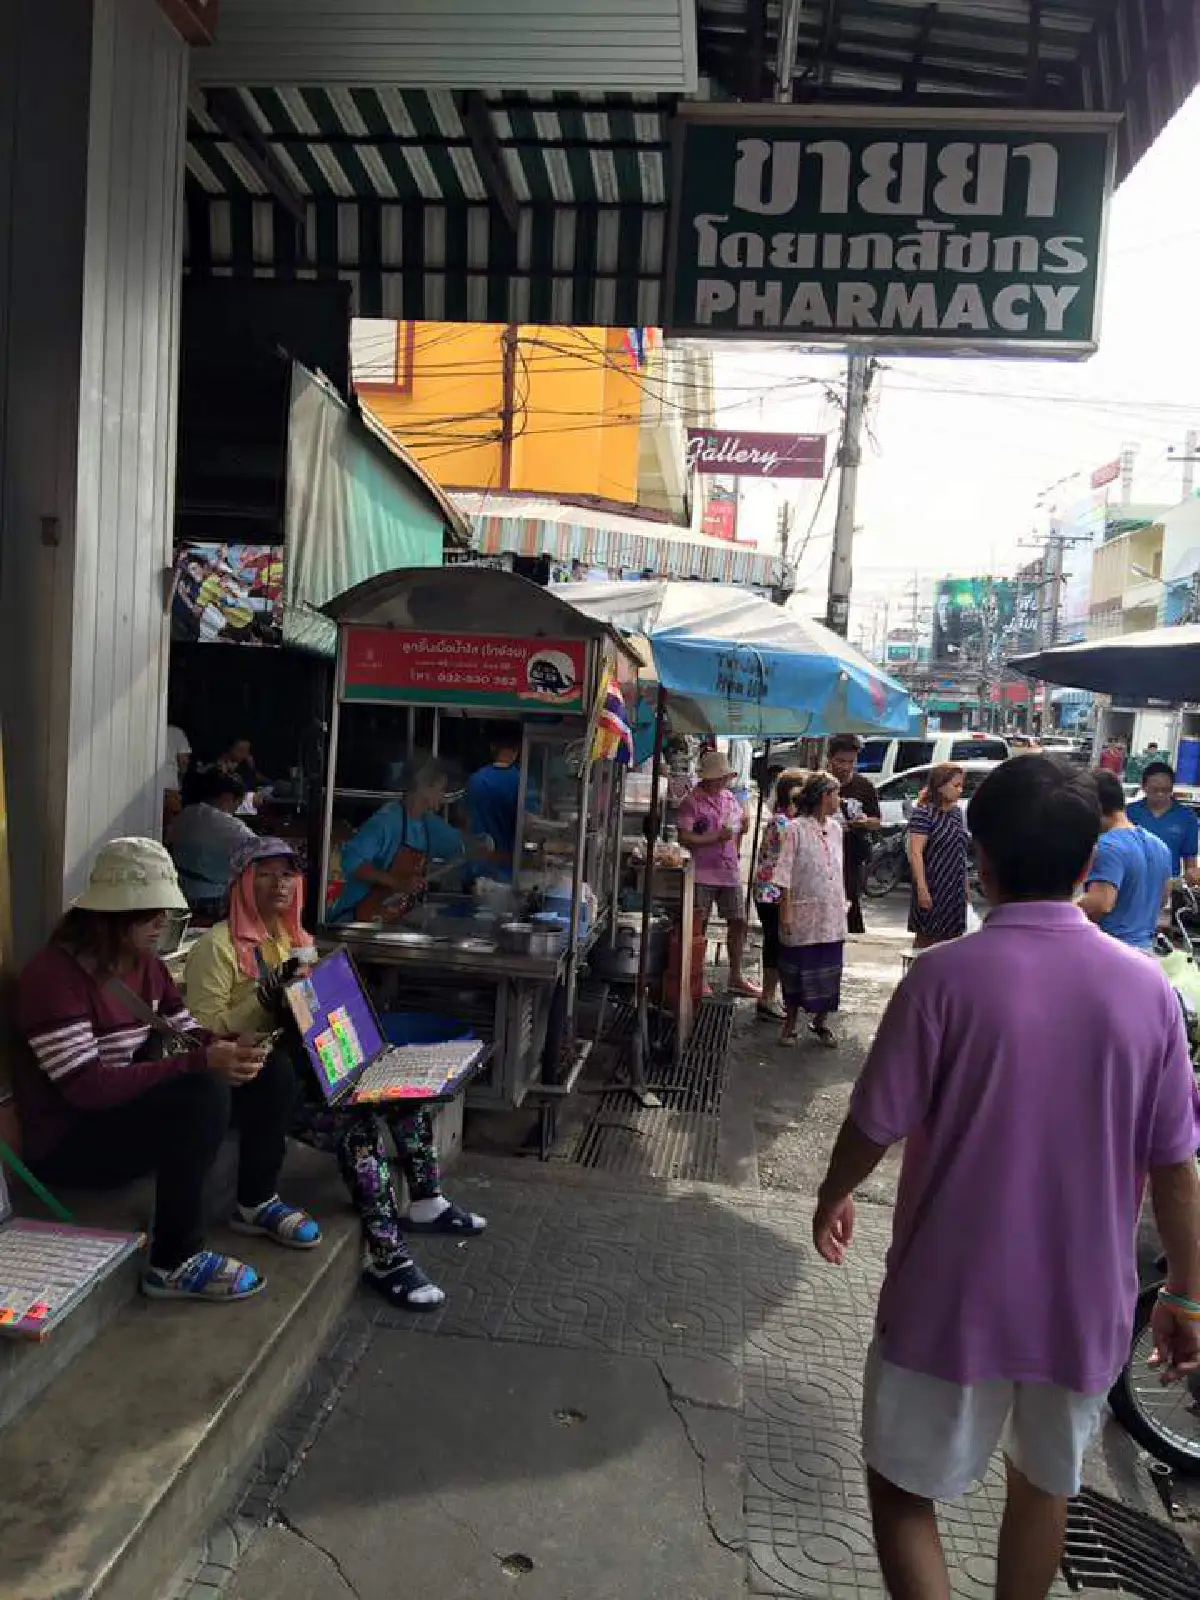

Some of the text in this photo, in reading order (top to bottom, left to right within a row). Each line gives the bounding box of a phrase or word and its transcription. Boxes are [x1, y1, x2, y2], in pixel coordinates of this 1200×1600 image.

[733, 138, 1058, 217] ขายยา
[693, 214, 1089, 274] โดยเภสัชกร
[694, 279, 1080, 332] PHARMACY
[686, 437, 778, 473] Gallery
